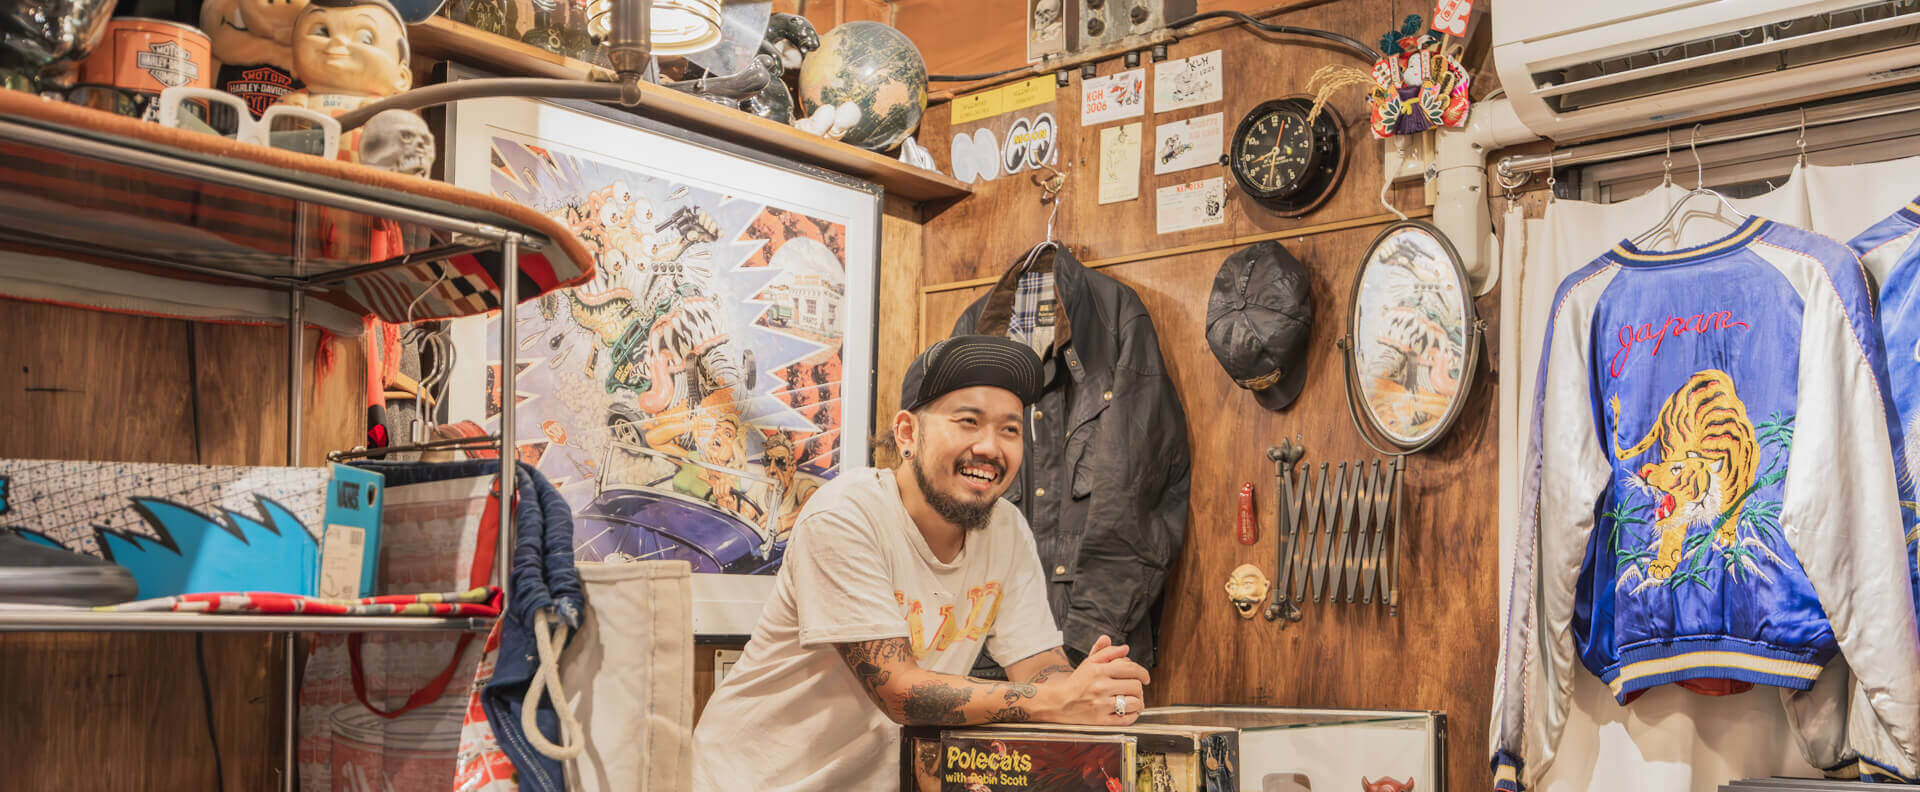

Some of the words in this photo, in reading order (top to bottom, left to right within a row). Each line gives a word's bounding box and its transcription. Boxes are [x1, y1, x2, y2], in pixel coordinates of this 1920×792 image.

[247, 71, 287, 84] MOTOR
[1086, 89, 1104, 103] KGH
[1086, 101, 1107, 115] 3006
[1013, 128, 1047, 145] MOON
[947, 746, 1032, 773] Polecats
[945, 772, 966, 784] with
[966, 773, 998, 786] Robin
[1000, 773, 1028, 787] Scott
